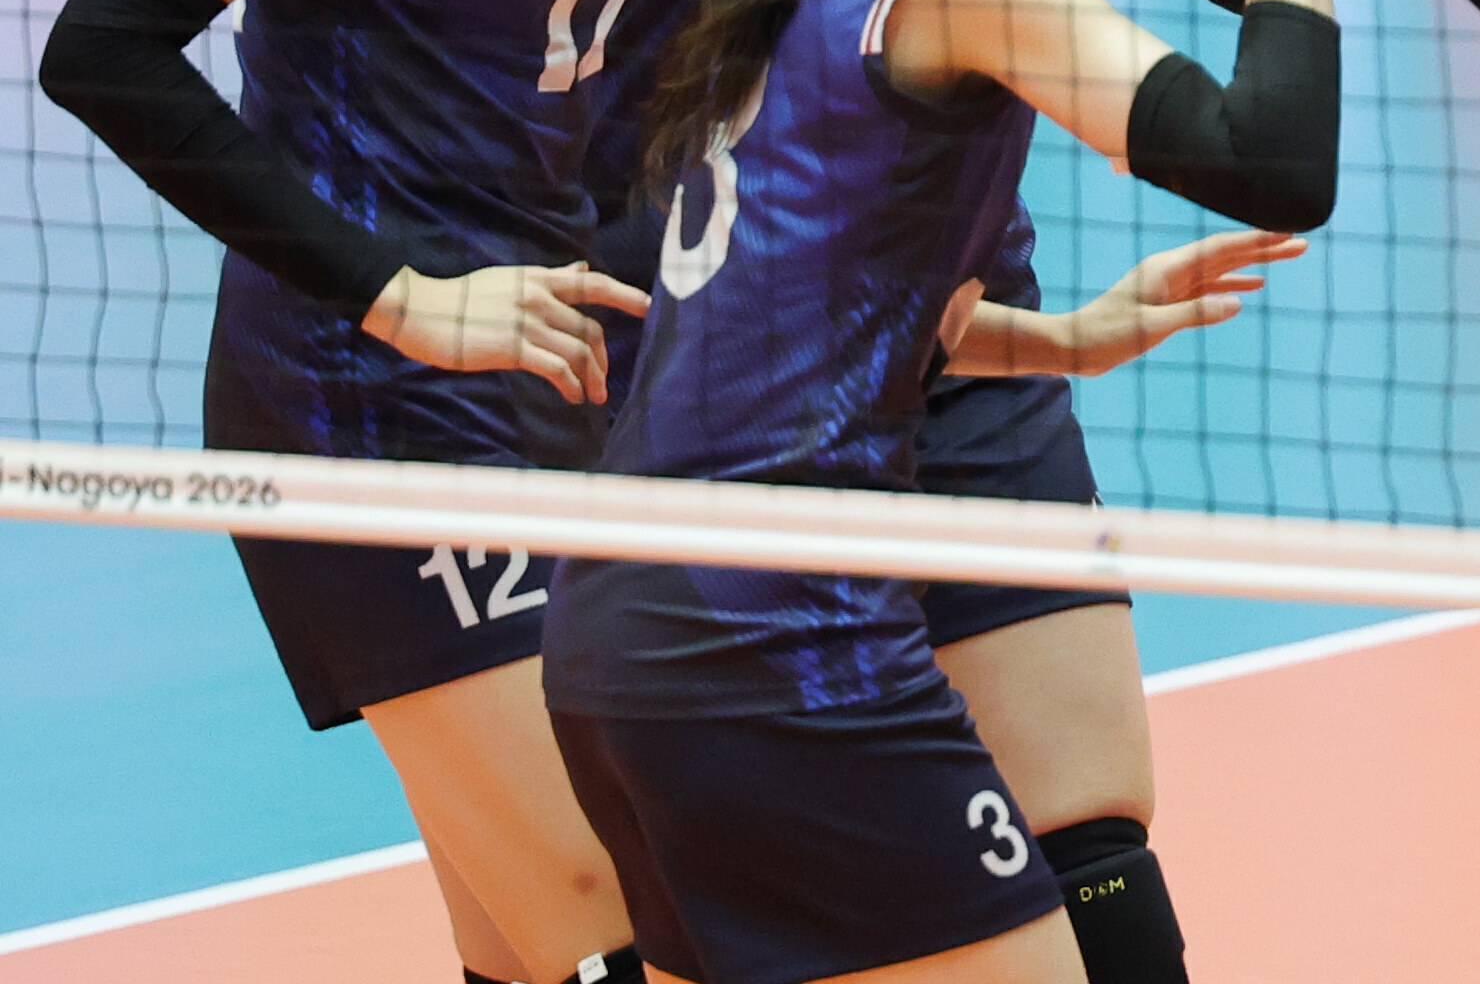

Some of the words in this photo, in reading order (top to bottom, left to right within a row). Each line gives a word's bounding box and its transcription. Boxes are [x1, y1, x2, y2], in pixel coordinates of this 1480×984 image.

[187, 471, 282, 507] 2026
[418, 542, 549, 629] 12
[966, 789, 1029, 877] 3
